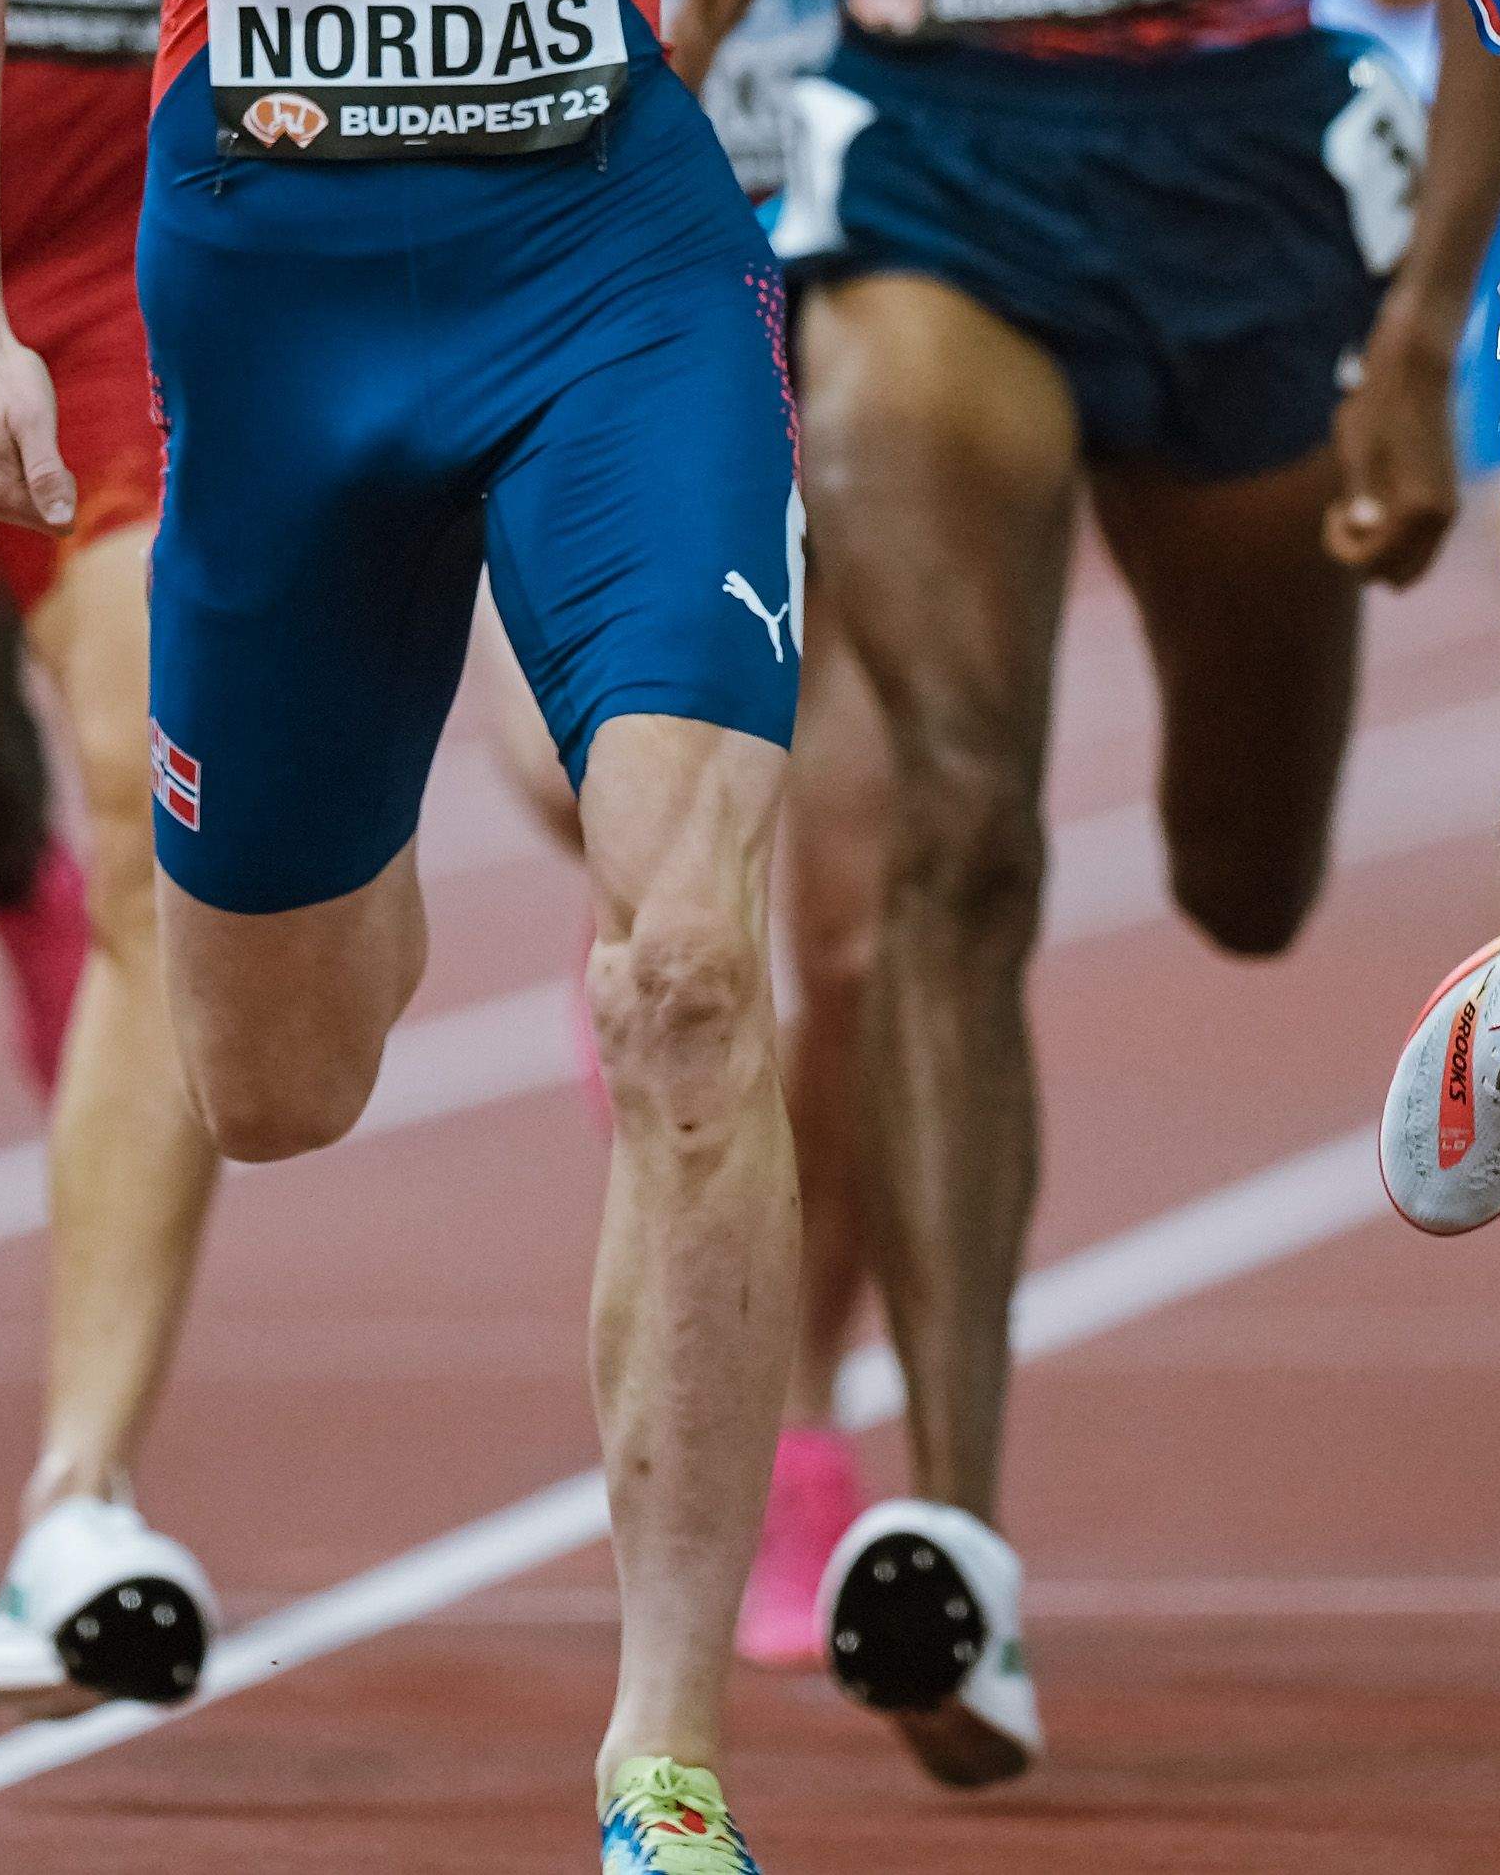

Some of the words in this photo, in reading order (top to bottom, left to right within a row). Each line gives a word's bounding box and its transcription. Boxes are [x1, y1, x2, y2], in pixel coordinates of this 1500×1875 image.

[340, 93, 556, 137] BUDAPEST
[559, 84, 611, 122] 23
[1449, 1000, 1476, 1106] BROOKS
